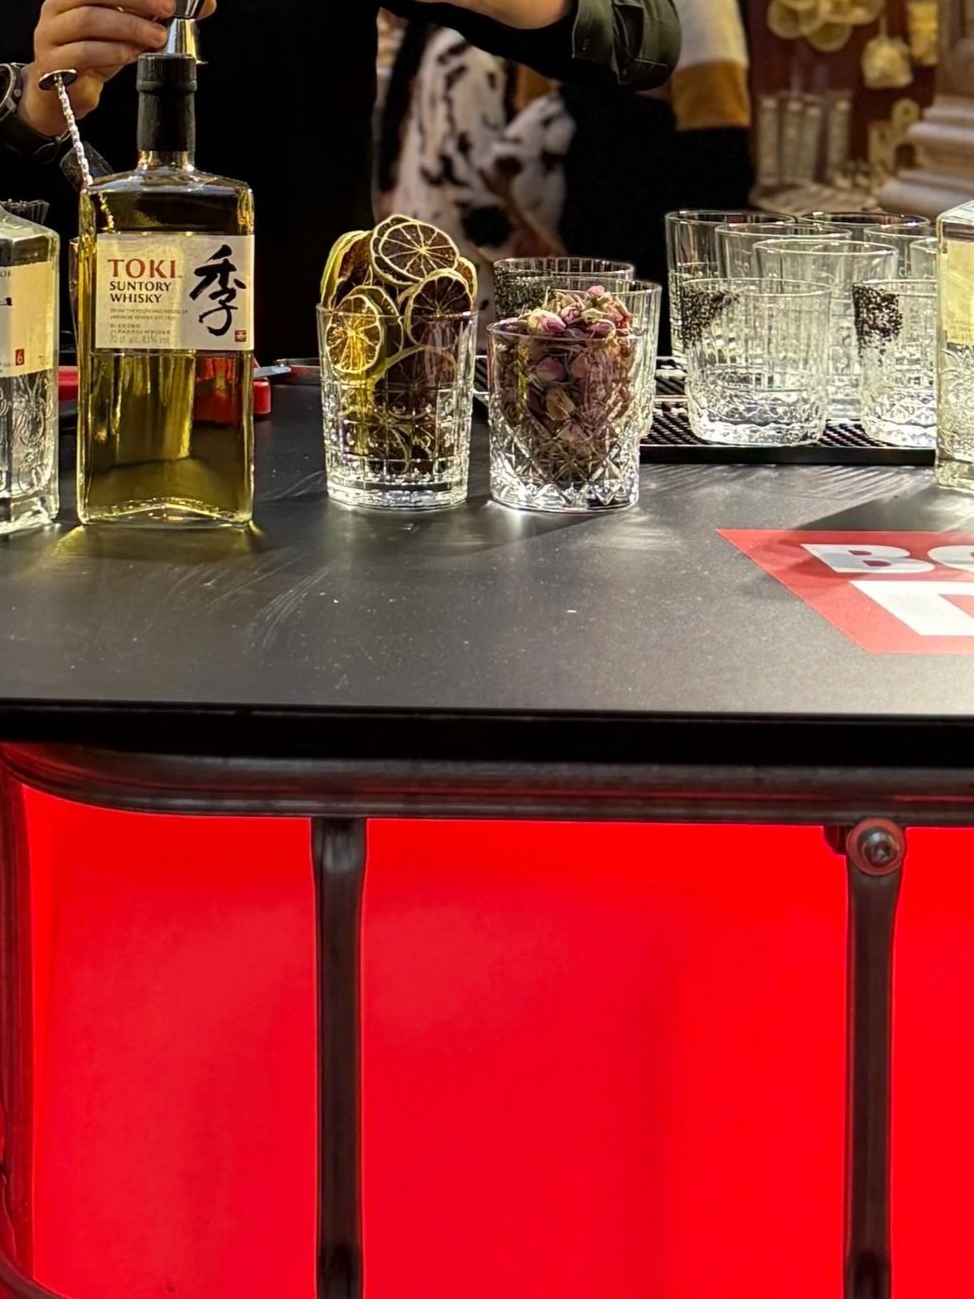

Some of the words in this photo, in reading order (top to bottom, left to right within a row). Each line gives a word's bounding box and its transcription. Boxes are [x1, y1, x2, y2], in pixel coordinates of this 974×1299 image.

[107, 258, 177, 279] TOKI
[109, 280, 173, 292] SUNTORY
[188, 244, 247, 337] 季
[109, 293, 163, 304] WHISKY
